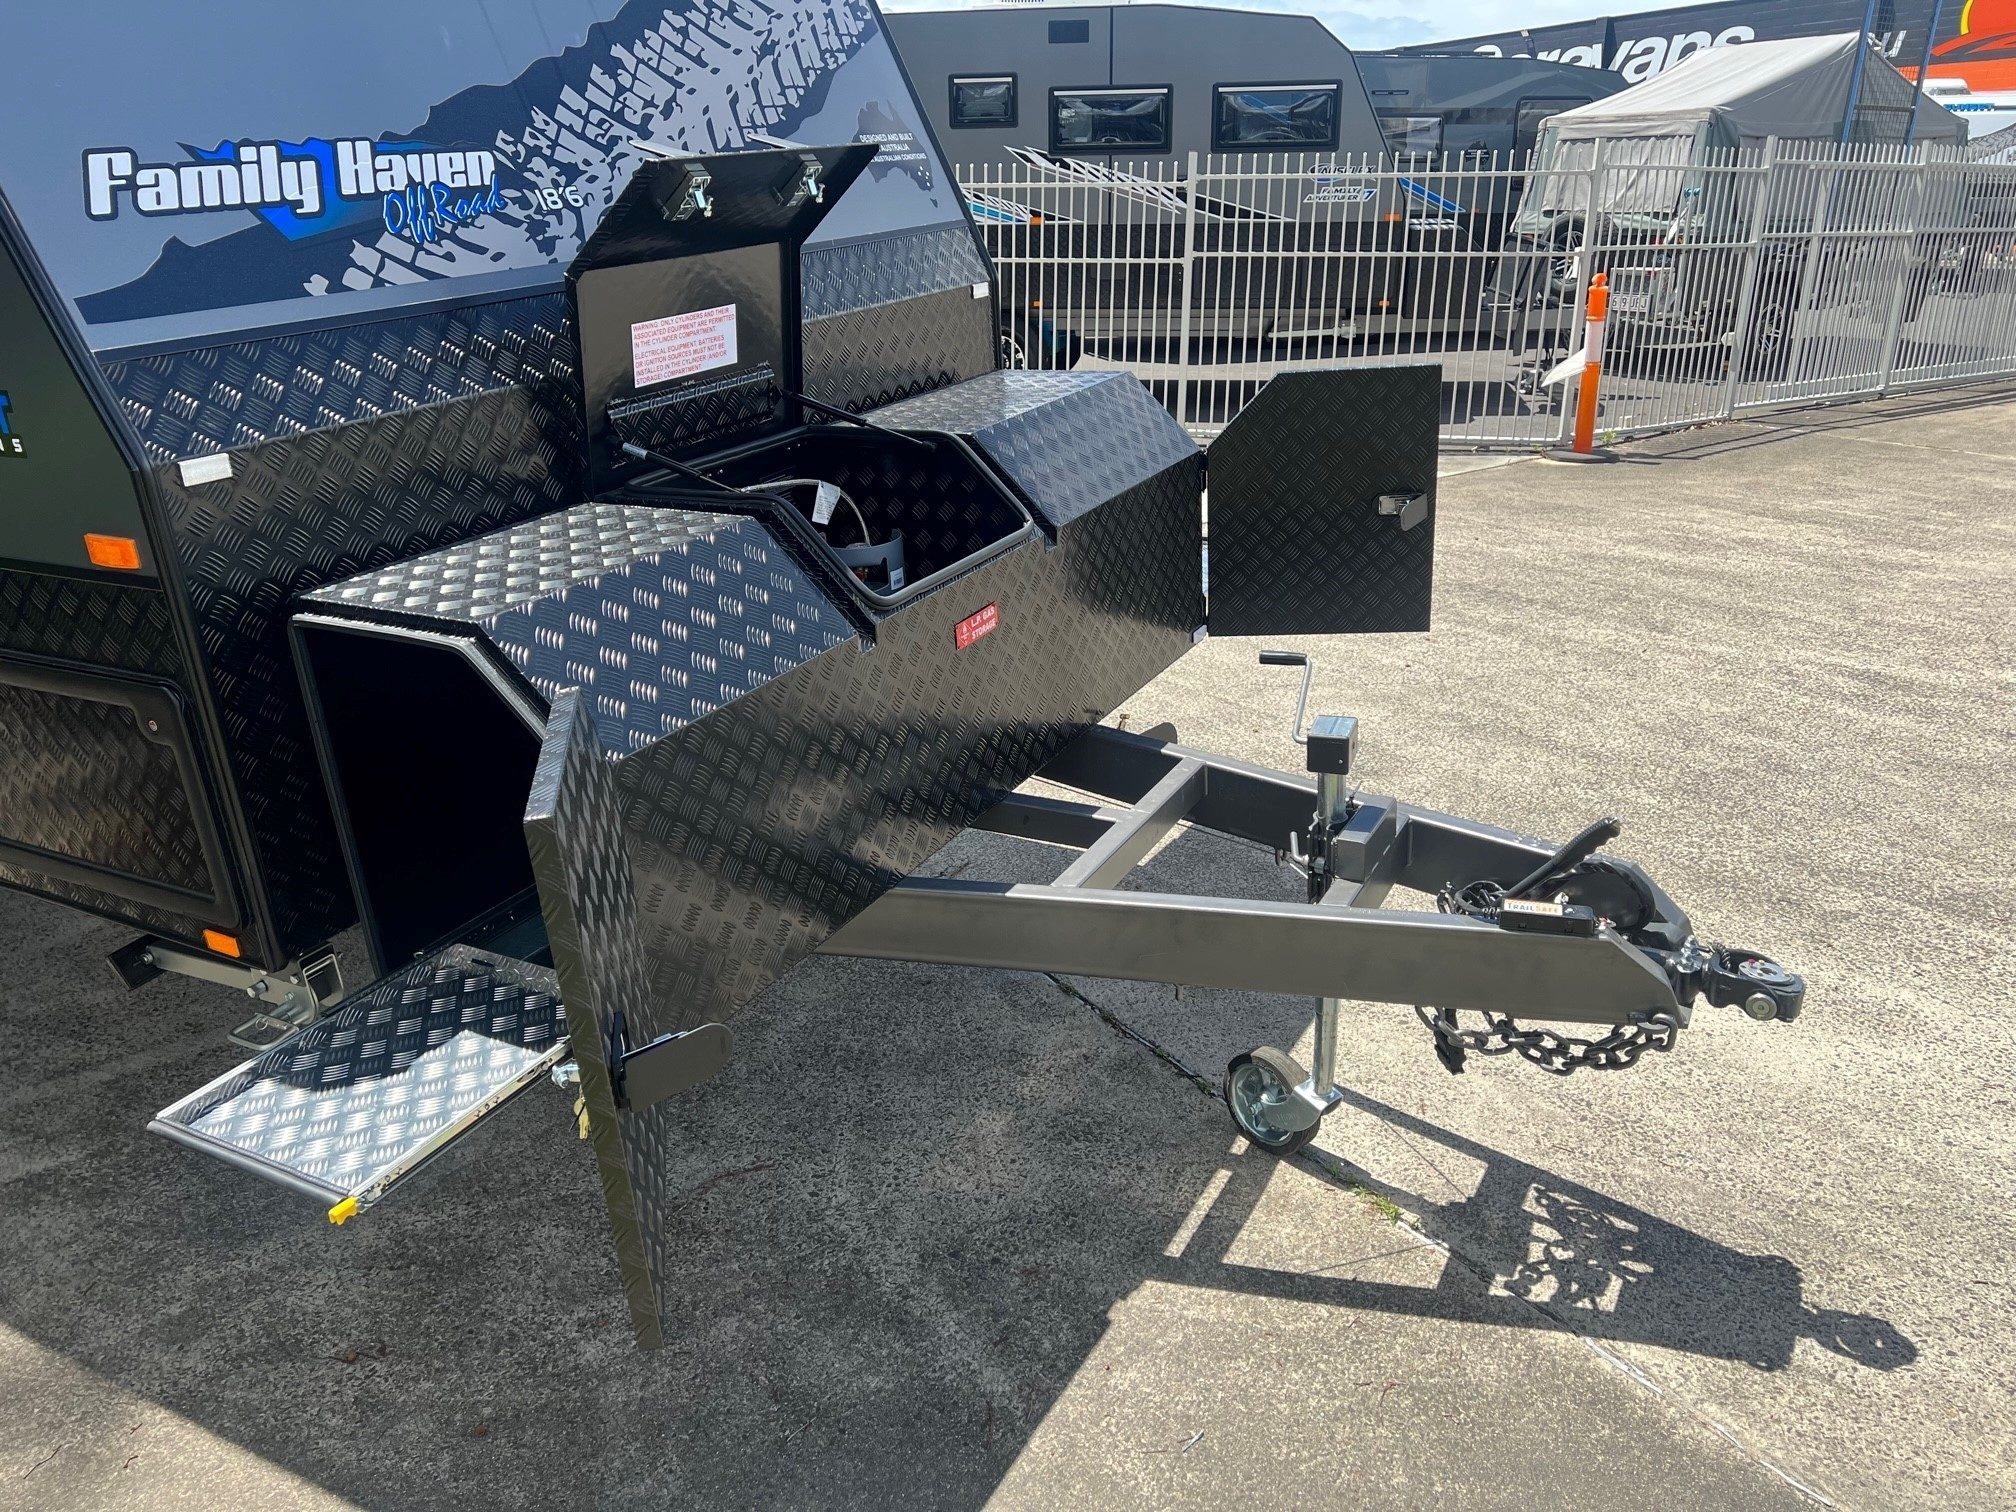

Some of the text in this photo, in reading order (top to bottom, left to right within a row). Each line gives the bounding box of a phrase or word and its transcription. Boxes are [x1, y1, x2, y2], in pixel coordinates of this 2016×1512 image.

[859, 132, 914, 144] DESIGNED AND BUILT
[880, 143, 910, 152] AUSTRALIA
[86, 140, 496, 214] Family Haven
[675, 313, 703, 324] CYLINDERS
[704, 310, 714, 318] AND
[716, 307, 729, 315] THEIR
[634, 328, 666, 340] ASSOCIATED
[667, 322, 696, 333] EQUIPMENT
[709, 314, 734, 324] PERMITTED
[635, 348, 666, 360] ELECTRICAL
[699, 334, 724, 345] BATTERIES
[652, 334, 677, 345] CYLINDER
[636, 365, 663, 377] INSTALLED
[682, 355, 706, 365] CYLINDER
[644, 356, 666, 366] IGNITION
[668, 350, 692, 360] SOURCES
[983, 606, 995, 620] GAS
[971, 618, 996, 639] STORAGE
